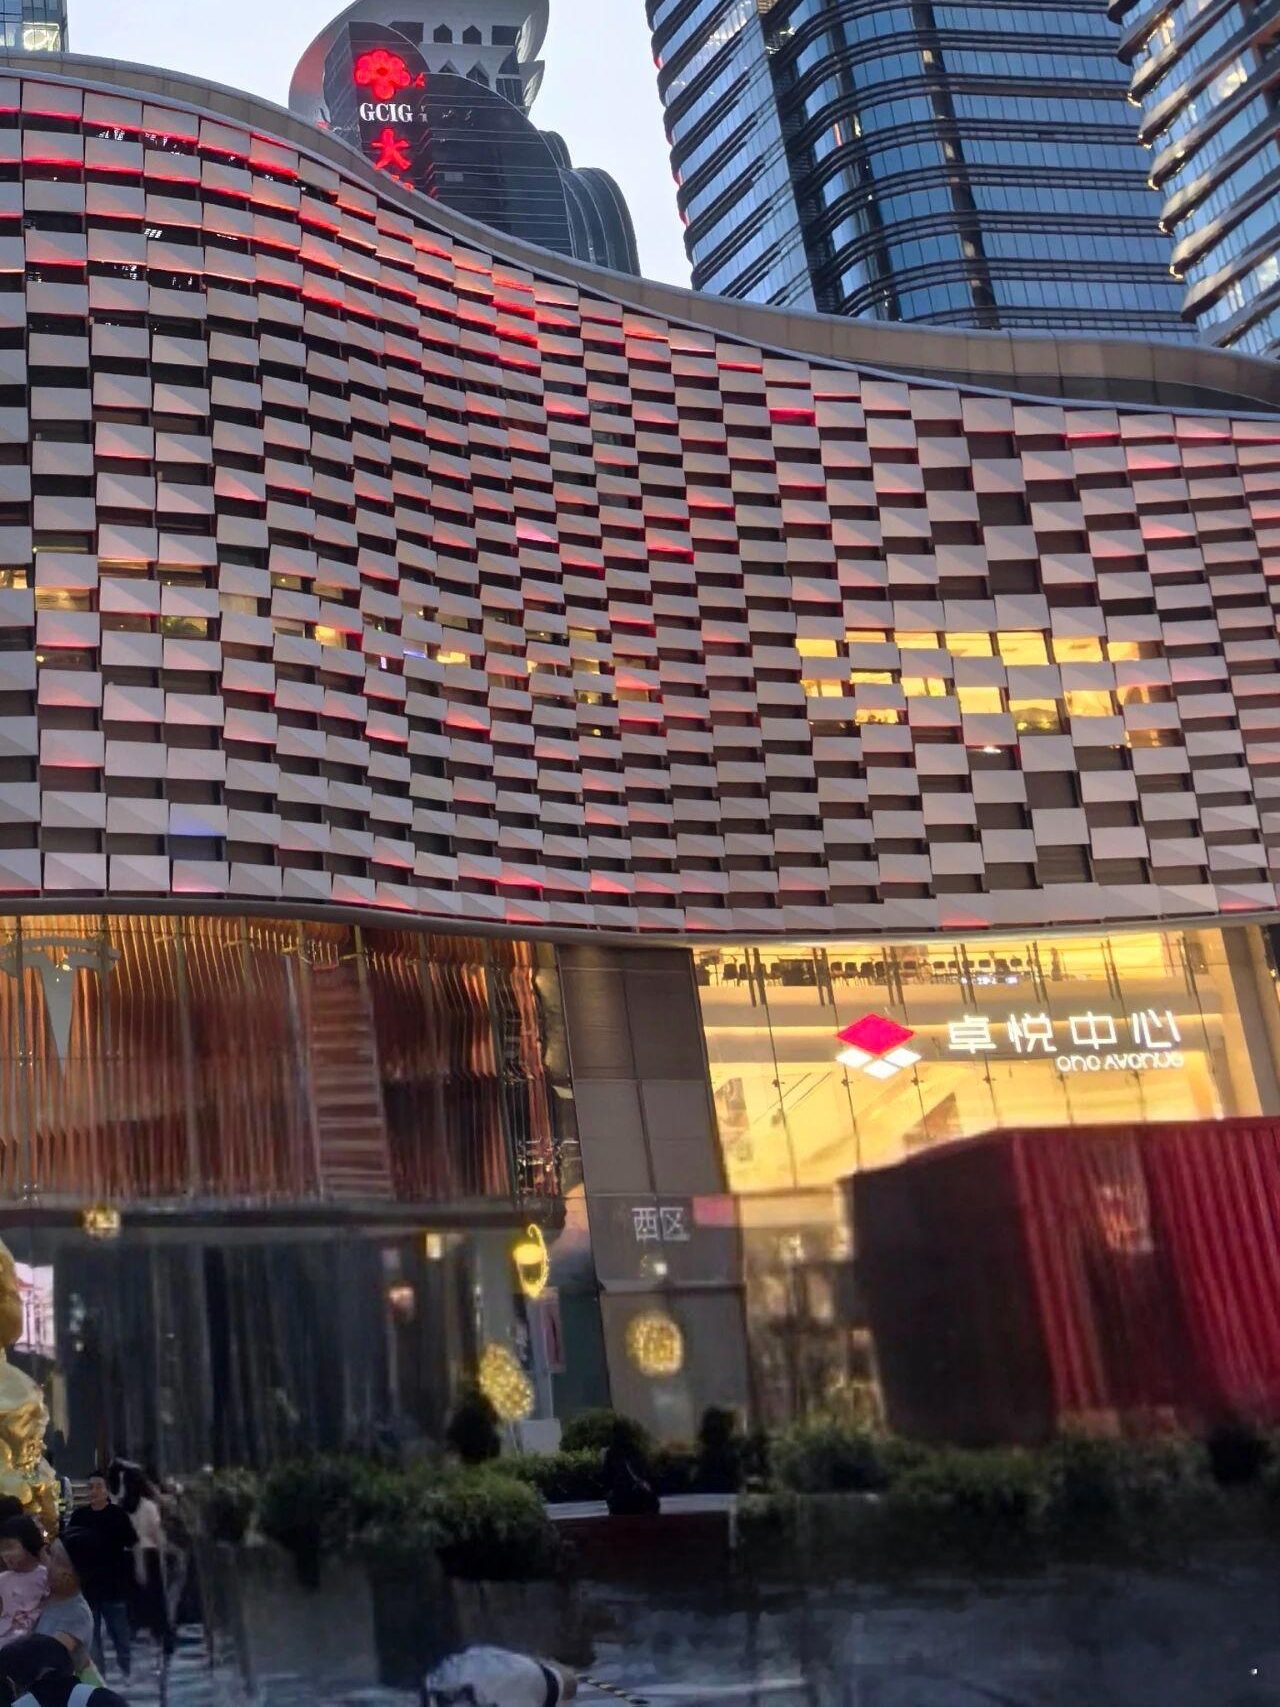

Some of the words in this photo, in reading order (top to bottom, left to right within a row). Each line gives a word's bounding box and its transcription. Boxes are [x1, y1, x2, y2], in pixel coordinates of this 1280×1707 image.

[359, 102, 414, 123] GCIG
[371, 126, 414, 191] 大
[948, 1009, 1181, 1054] 卓悦中心
[631, 1206, 690, 1242] 西区
